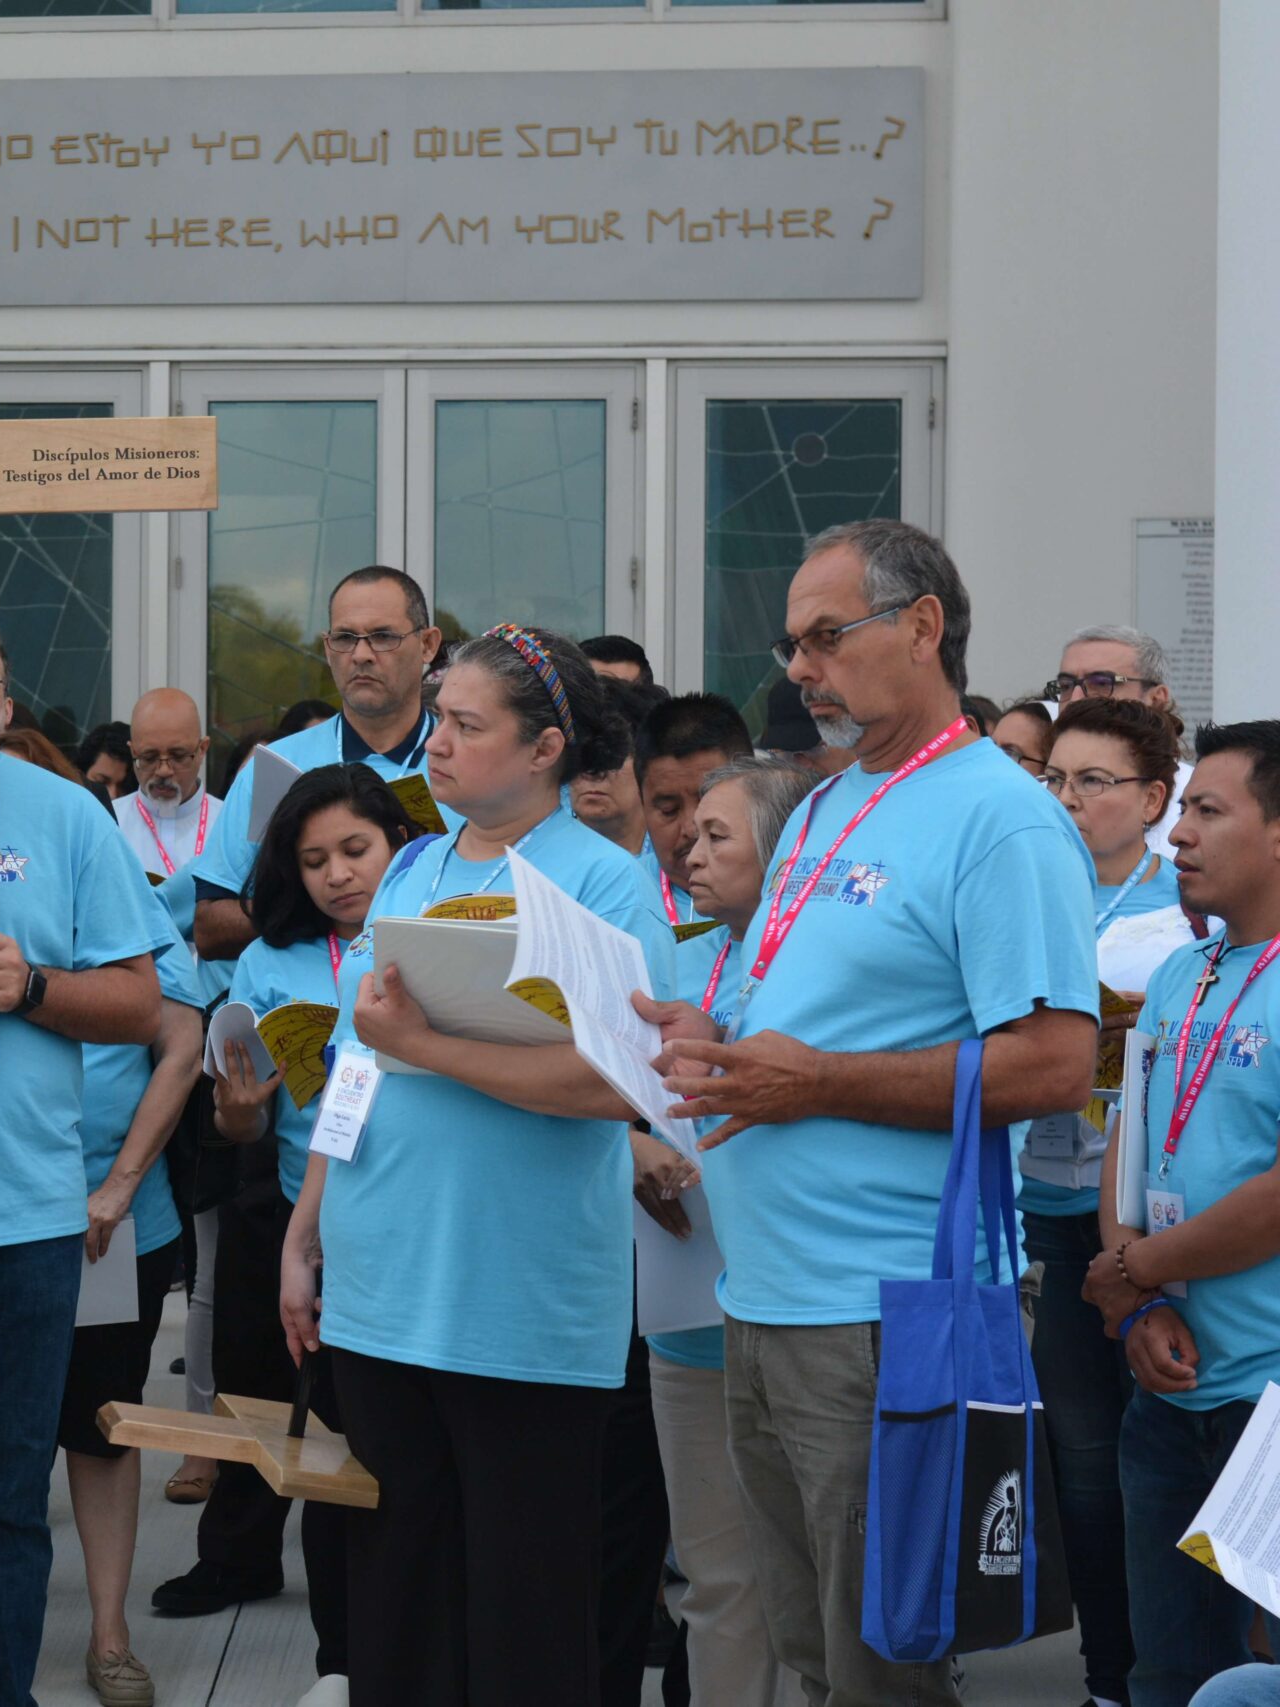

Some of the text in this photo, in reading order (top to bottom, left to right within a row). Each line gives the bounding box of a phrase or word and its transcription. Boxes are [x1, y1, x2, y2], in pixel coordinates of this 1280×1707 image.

[192, 132, 260, 162] YO
[415, 127, 501, 159] QUE
[517, 123, 616, 157] SOY
[637, 120, 678, 154] TU
[13, 216, 19, 252] I
[37, 216, 128, 248] NOT
[145, 217, 281, 251] HERE,
[300, 214, 398, 246] WHO
[421, 213, 488, 240] AM
[516, 211, 620, 243] YOUR
[33, 448, 199, 465] Discípulos Misioneros:
[3, 467, 200, 485] Testigos del Amor de Dios
